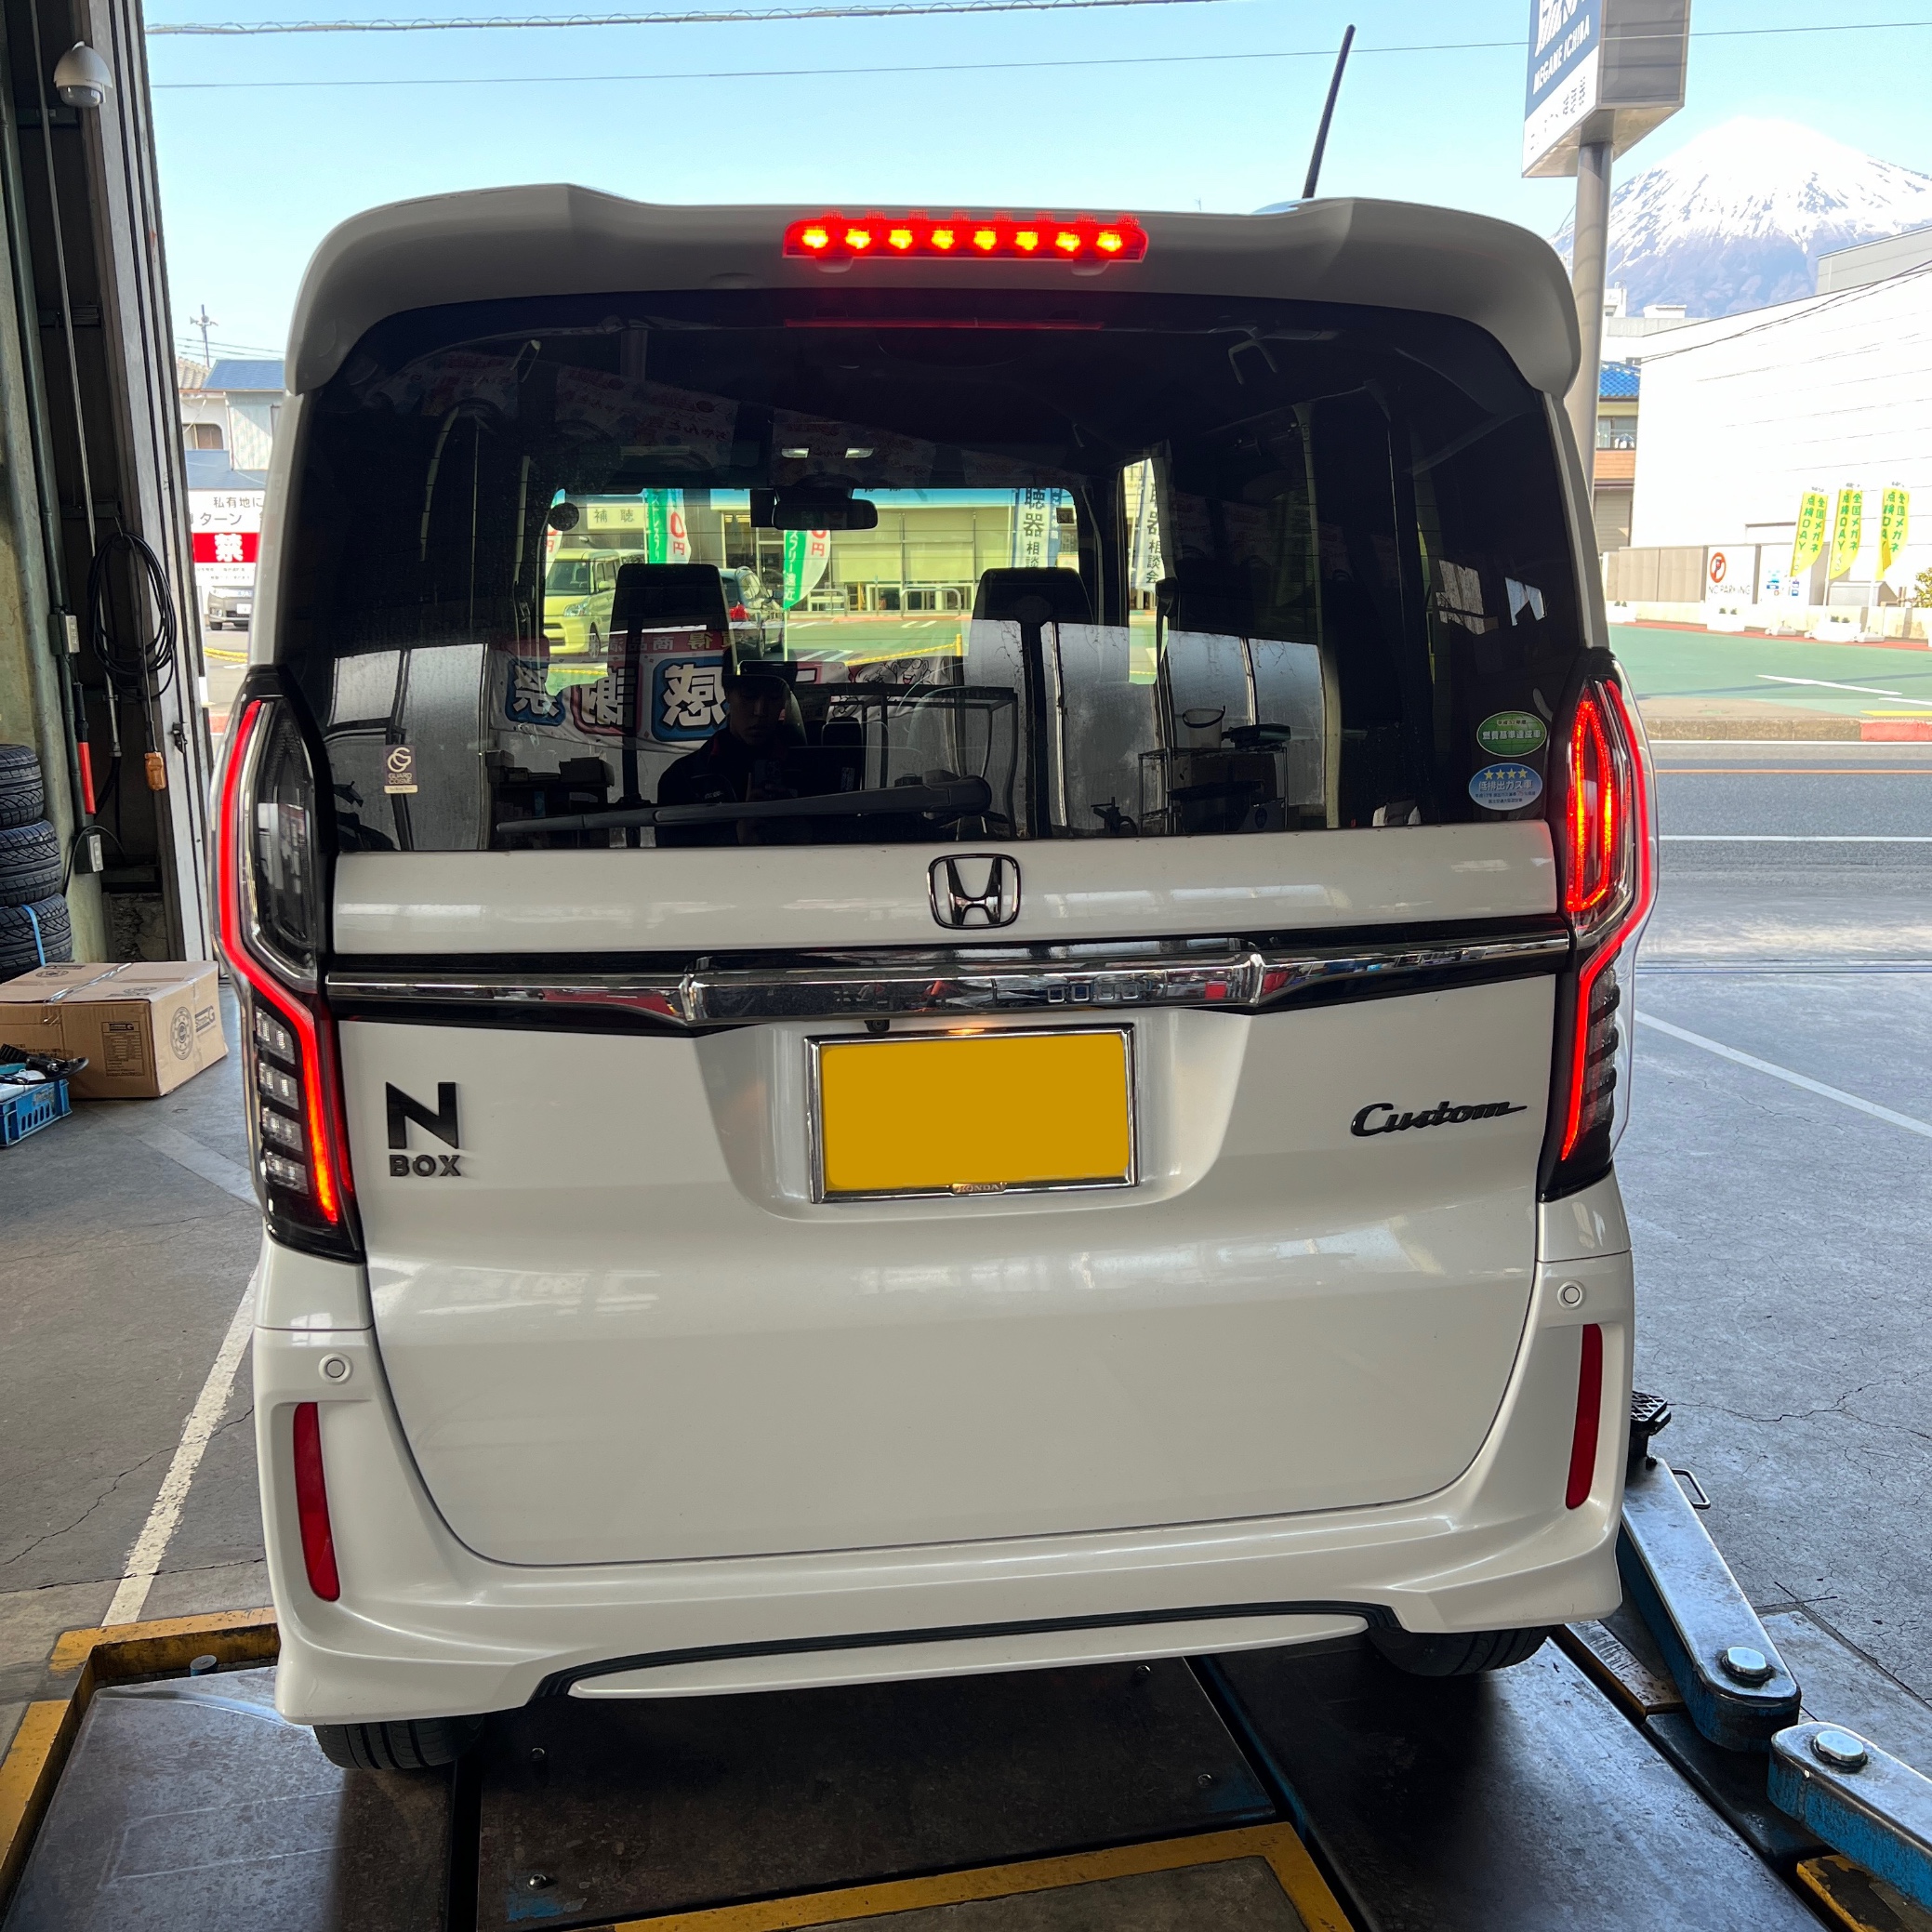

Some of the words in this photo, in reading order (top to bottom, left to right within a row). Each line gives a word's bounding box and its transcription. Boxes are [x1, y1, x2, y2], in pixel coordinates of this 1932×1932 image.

[386, 1081, 459, 1149] N
[1350, 1101, 1528, 1137] Custom
[389, 1155, 461, 1177] BOX
[955, 1184, 999, 1193] HONDA
